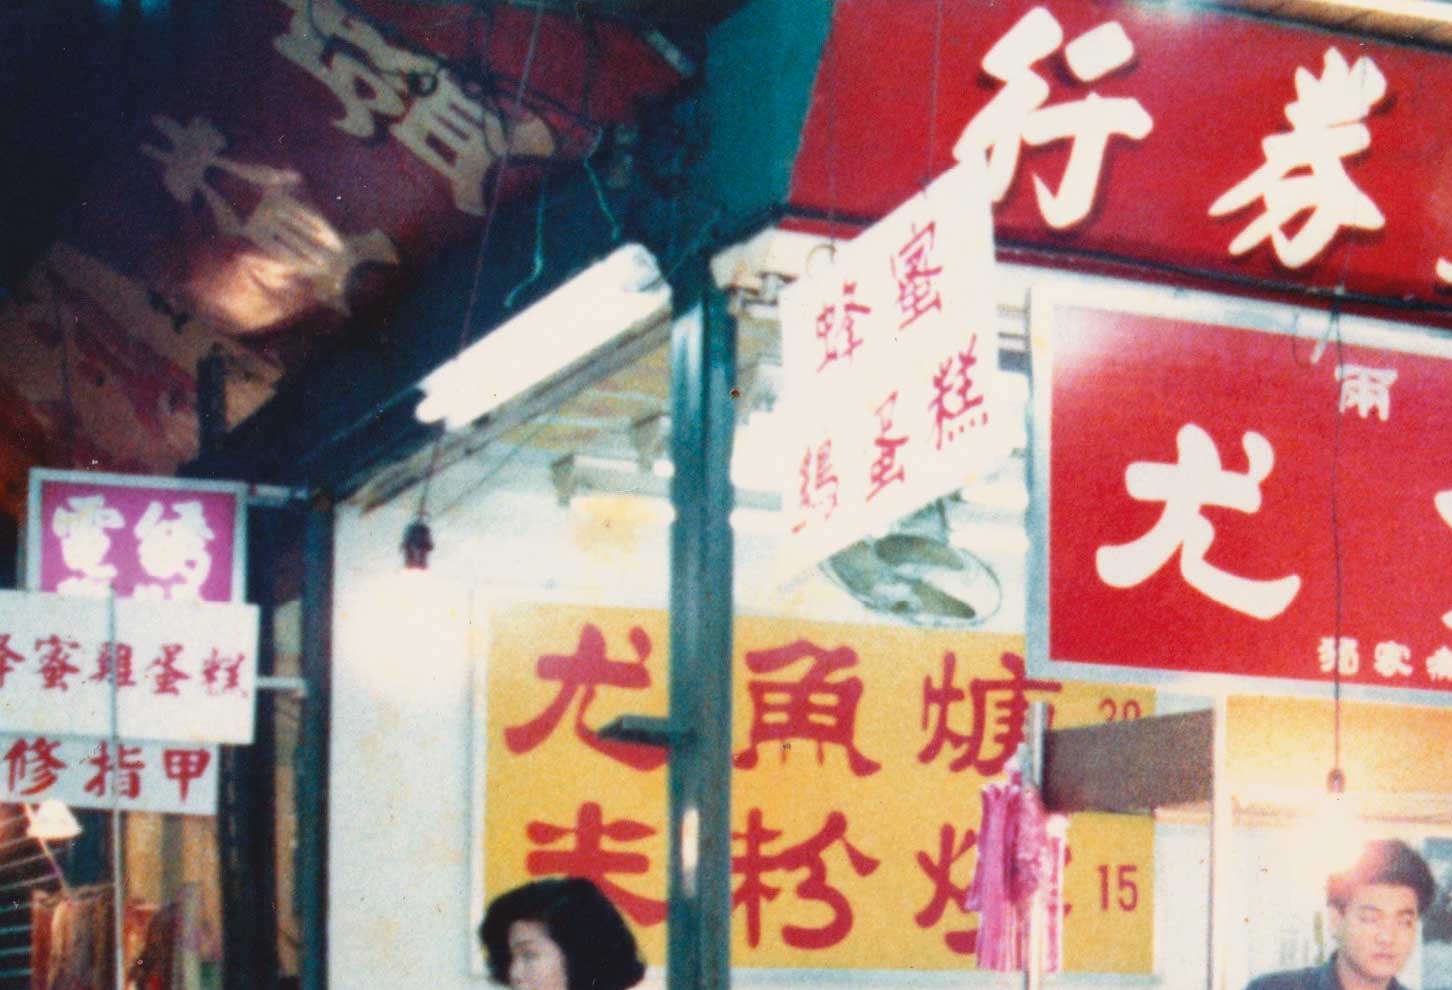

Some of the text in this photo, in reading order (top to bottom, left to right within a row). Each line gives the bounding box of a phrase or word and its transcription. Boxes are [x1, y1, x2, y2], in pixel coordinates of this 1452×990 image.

[2, 736, 212, 803] 修指甲
[1097, 864, 1140, 913] 15
